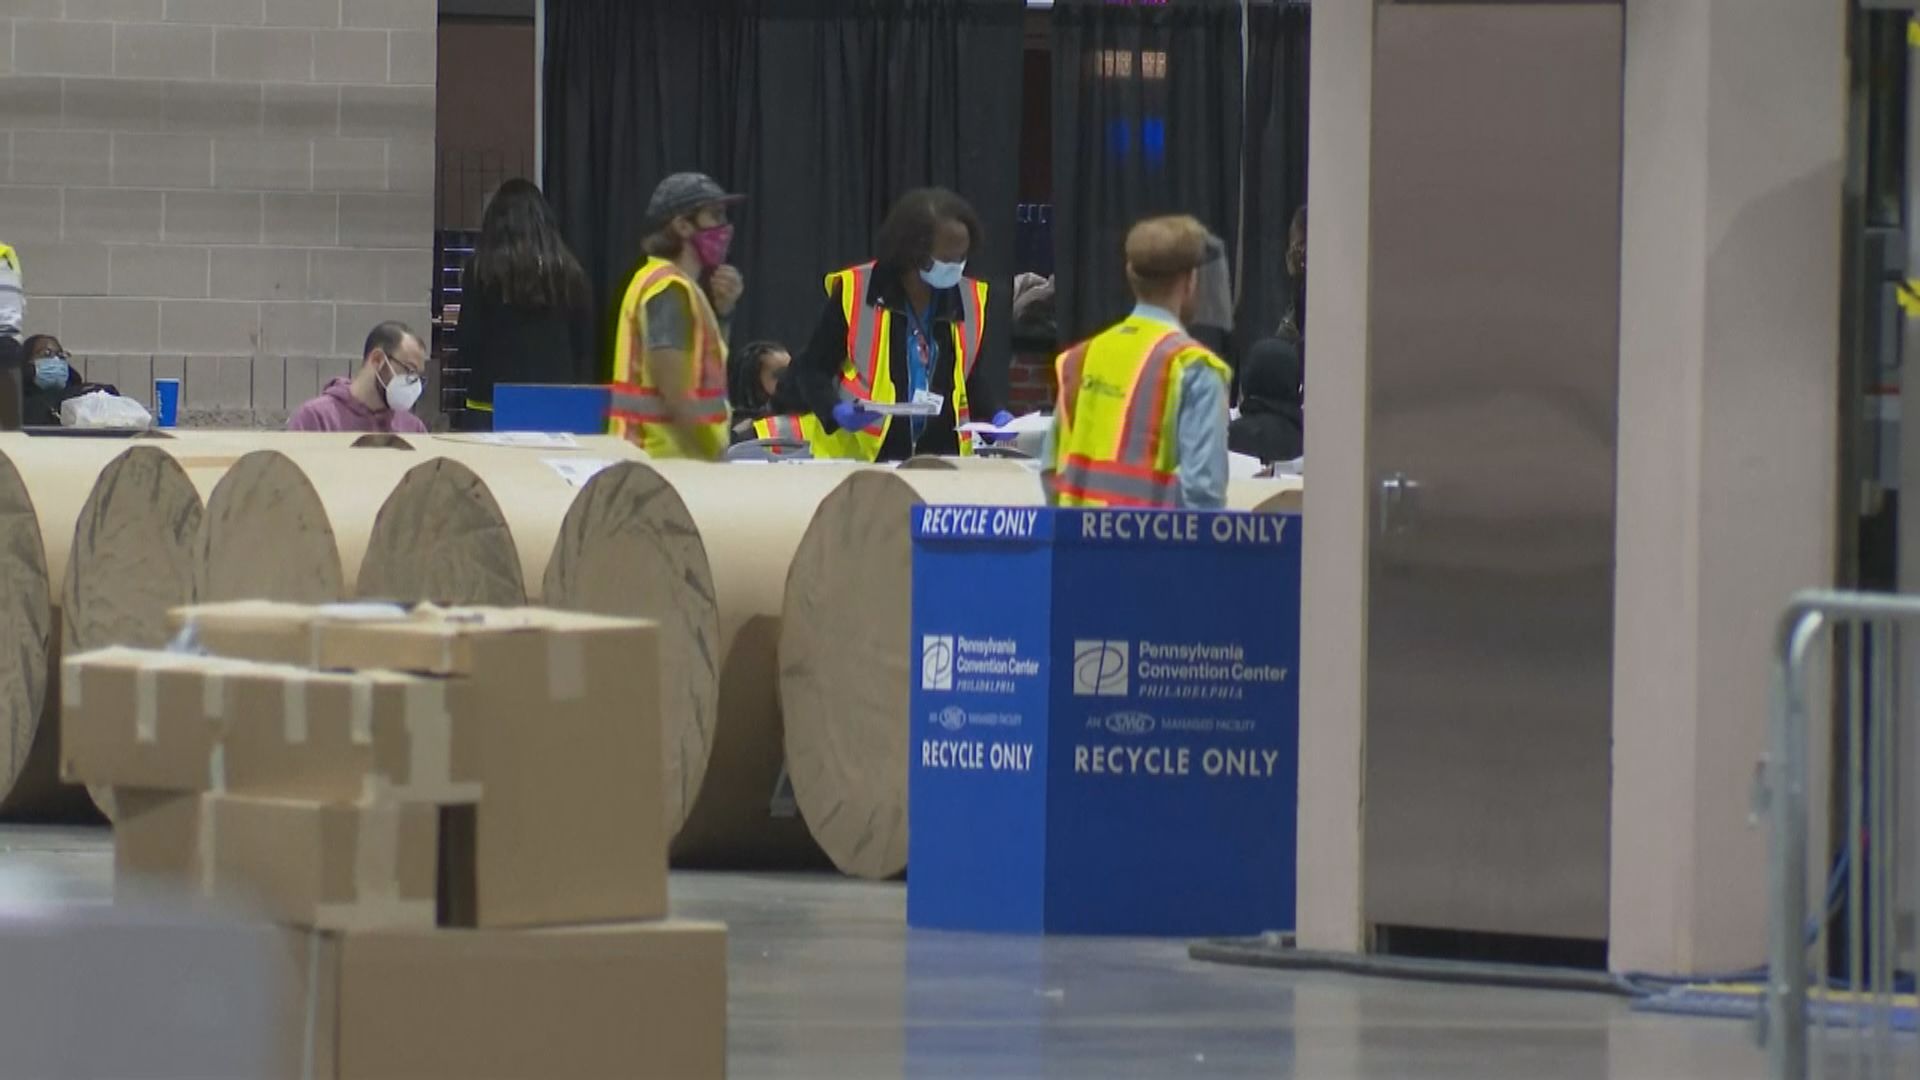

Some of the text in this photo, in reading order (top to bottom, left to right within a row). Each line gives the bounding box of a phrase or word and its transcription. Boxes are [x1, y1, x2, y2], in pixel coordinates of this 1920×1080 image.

[921, 507, 1038, 537] RECYCLE ONLY
[1082, 511, 1288, 543] RECYCLE ONLY
[958, 635, 1016, 657] Pennsylvania
[1138, 641, 1244, 663] Pennsylvania
[957, 655, 1039, 676] Convention Center
[1138, 661, 1288, 682] Convention Center
[1138, 684, 1243, 699] PHILADELPHIA
[922, 740, 1033, 771] RECYCLE ONLY
[1074, 746, 1280, 777] RECYCLE ONLY
